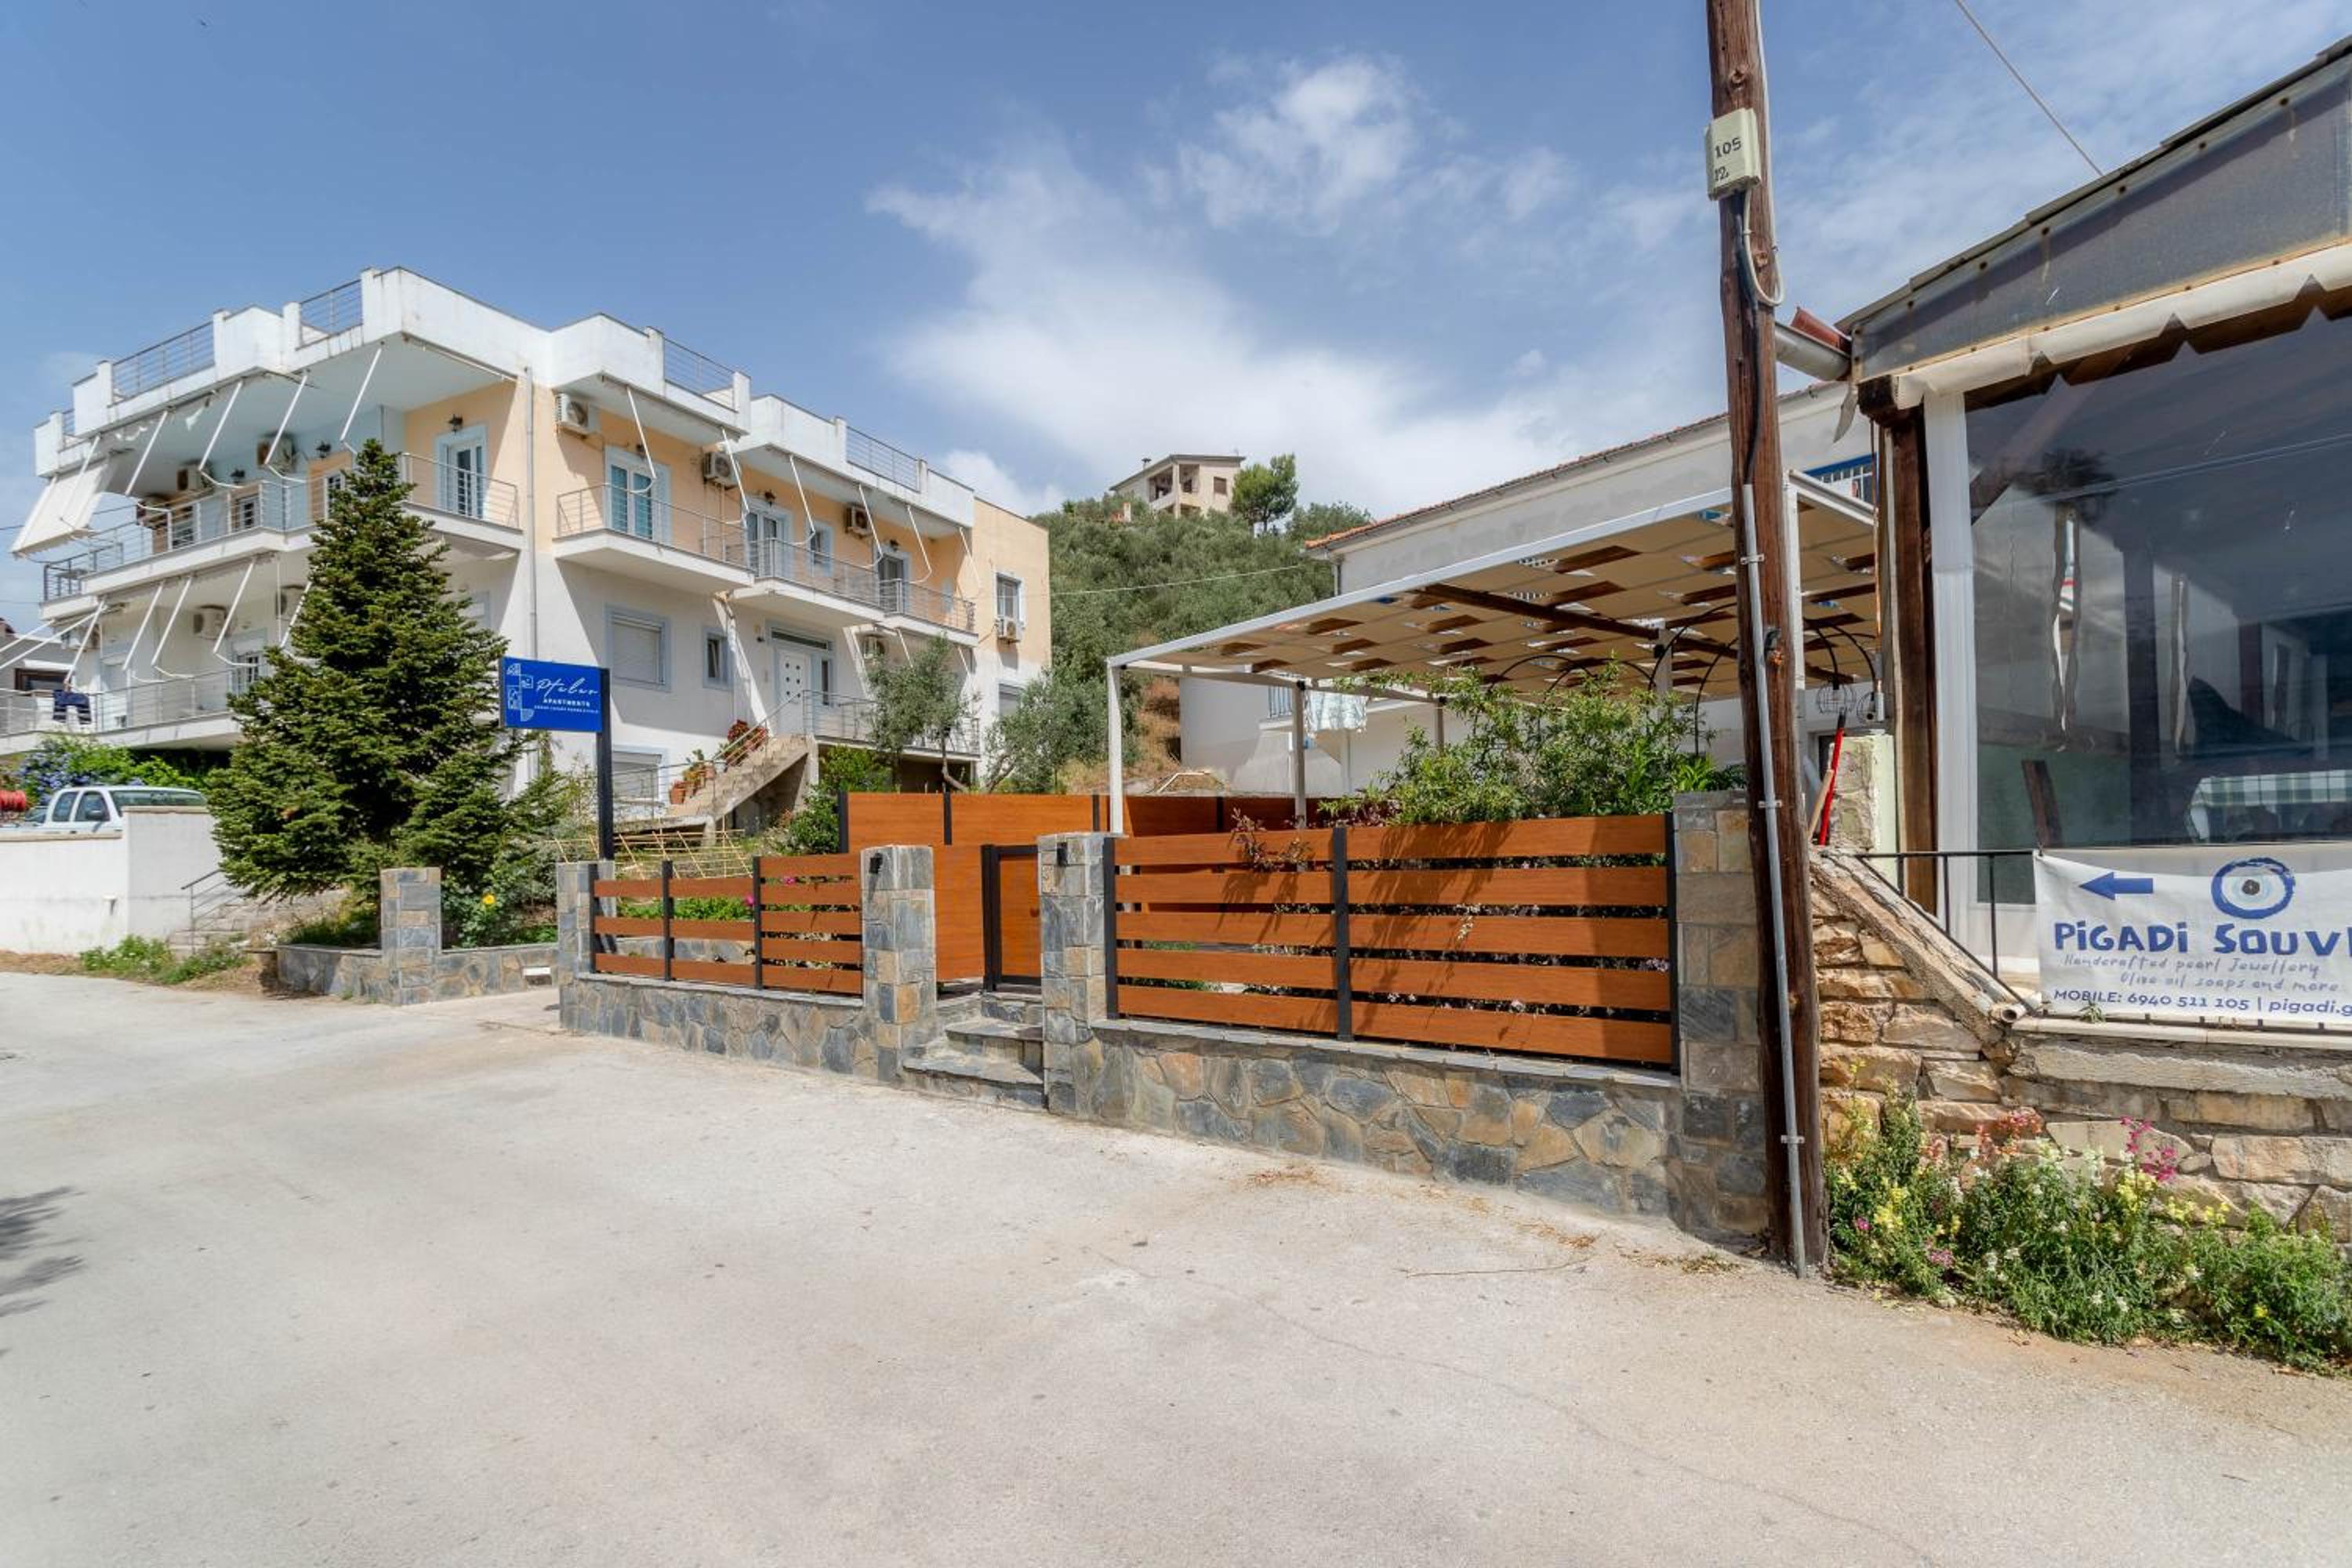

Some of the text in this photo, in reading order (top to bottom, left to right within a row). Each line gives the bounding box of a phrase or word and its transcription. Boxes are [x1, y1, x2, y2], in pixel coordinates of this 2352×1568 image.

[1715, 137, 1742, 158] 105
[543, 698, 591, 707] APARTMENTS
[2213, 923, 2352, 958] SOUV
[2063, 953, 2321, 978] Handcrafted pearl Jewellery
[2120, 972, 2158, 987] Olive
[2165, 975, 2187, 989] oil
[2194, 978, 2246, 991] soaps
[2252, 978, 2285, 991] and
[2053, 989, 2123, 1004] MOBILE:
[2127, 992, 2172, 1006] 6940
[2177, 996, 2208, 1008] 511
[2215, 997, 2250, 1011] 105
